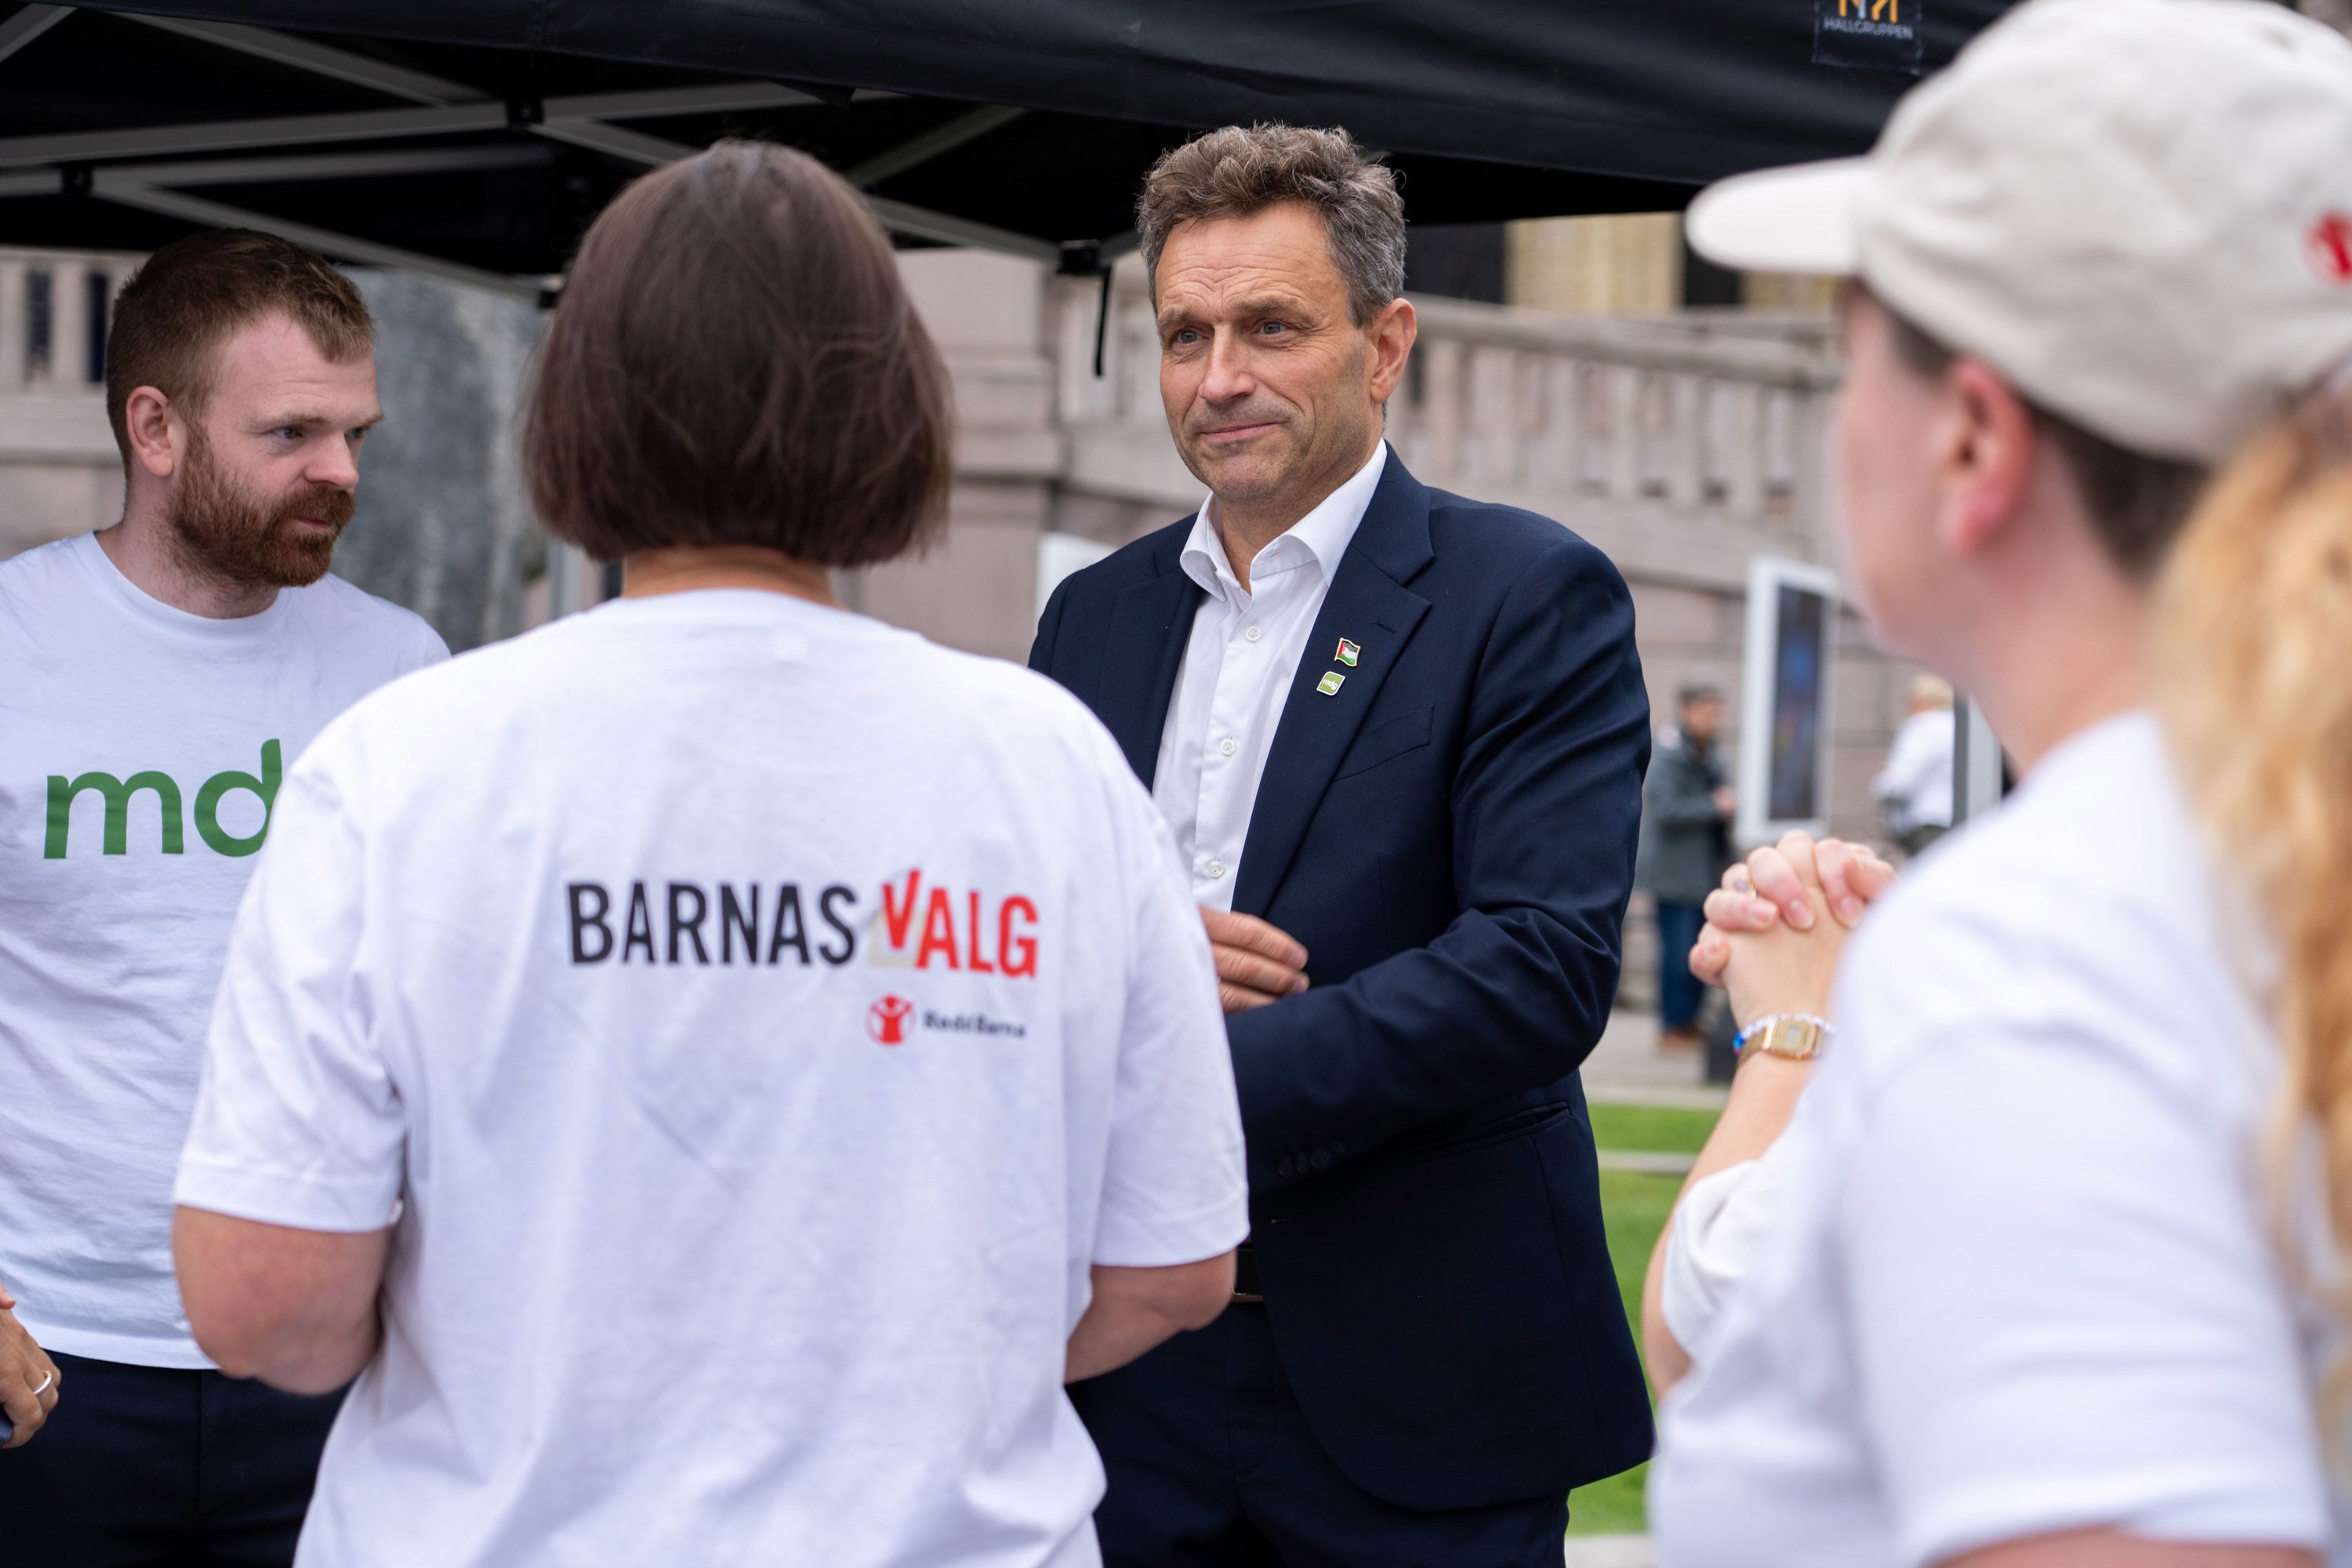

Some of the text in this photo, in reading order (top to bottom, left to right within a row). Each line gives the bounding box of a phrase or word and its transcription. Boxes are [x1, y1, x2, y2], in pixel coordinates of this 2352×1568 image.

[1823, 16, 1914, 39] HALLGRUPPEN
[568, 868, 1039, 979] BARNAS VALG
